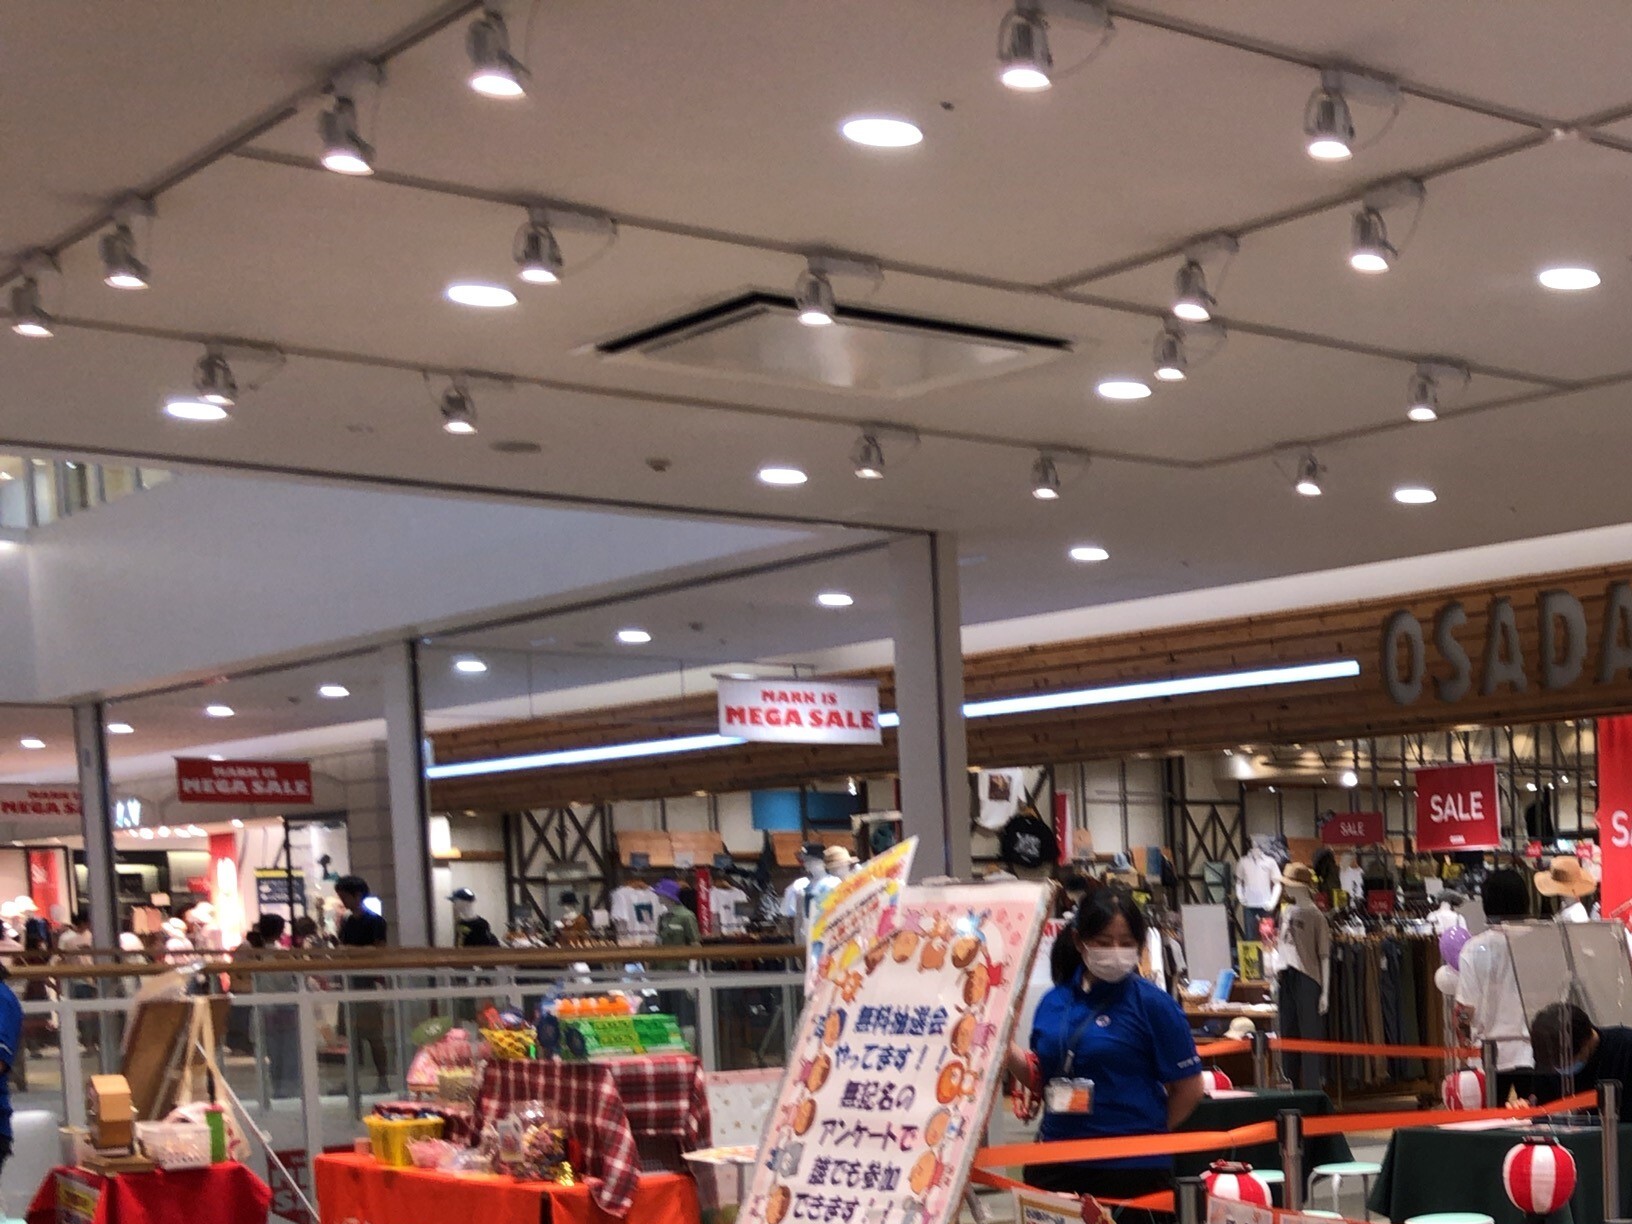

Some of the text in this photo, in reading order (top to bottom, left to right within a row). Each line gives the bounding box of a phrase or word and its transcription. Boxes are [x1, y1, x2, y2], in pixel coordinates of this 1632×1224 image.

[822, 692, 838, 705] IS
[725, 705, 876, 730] MEGA SALE
[251, 779, 310, 796] SALE
[1429, 790, 1485, 823] SALE
[1340, 821, 1366, 837] SALE
[819, 1119, 920, 1152] アンケートで
